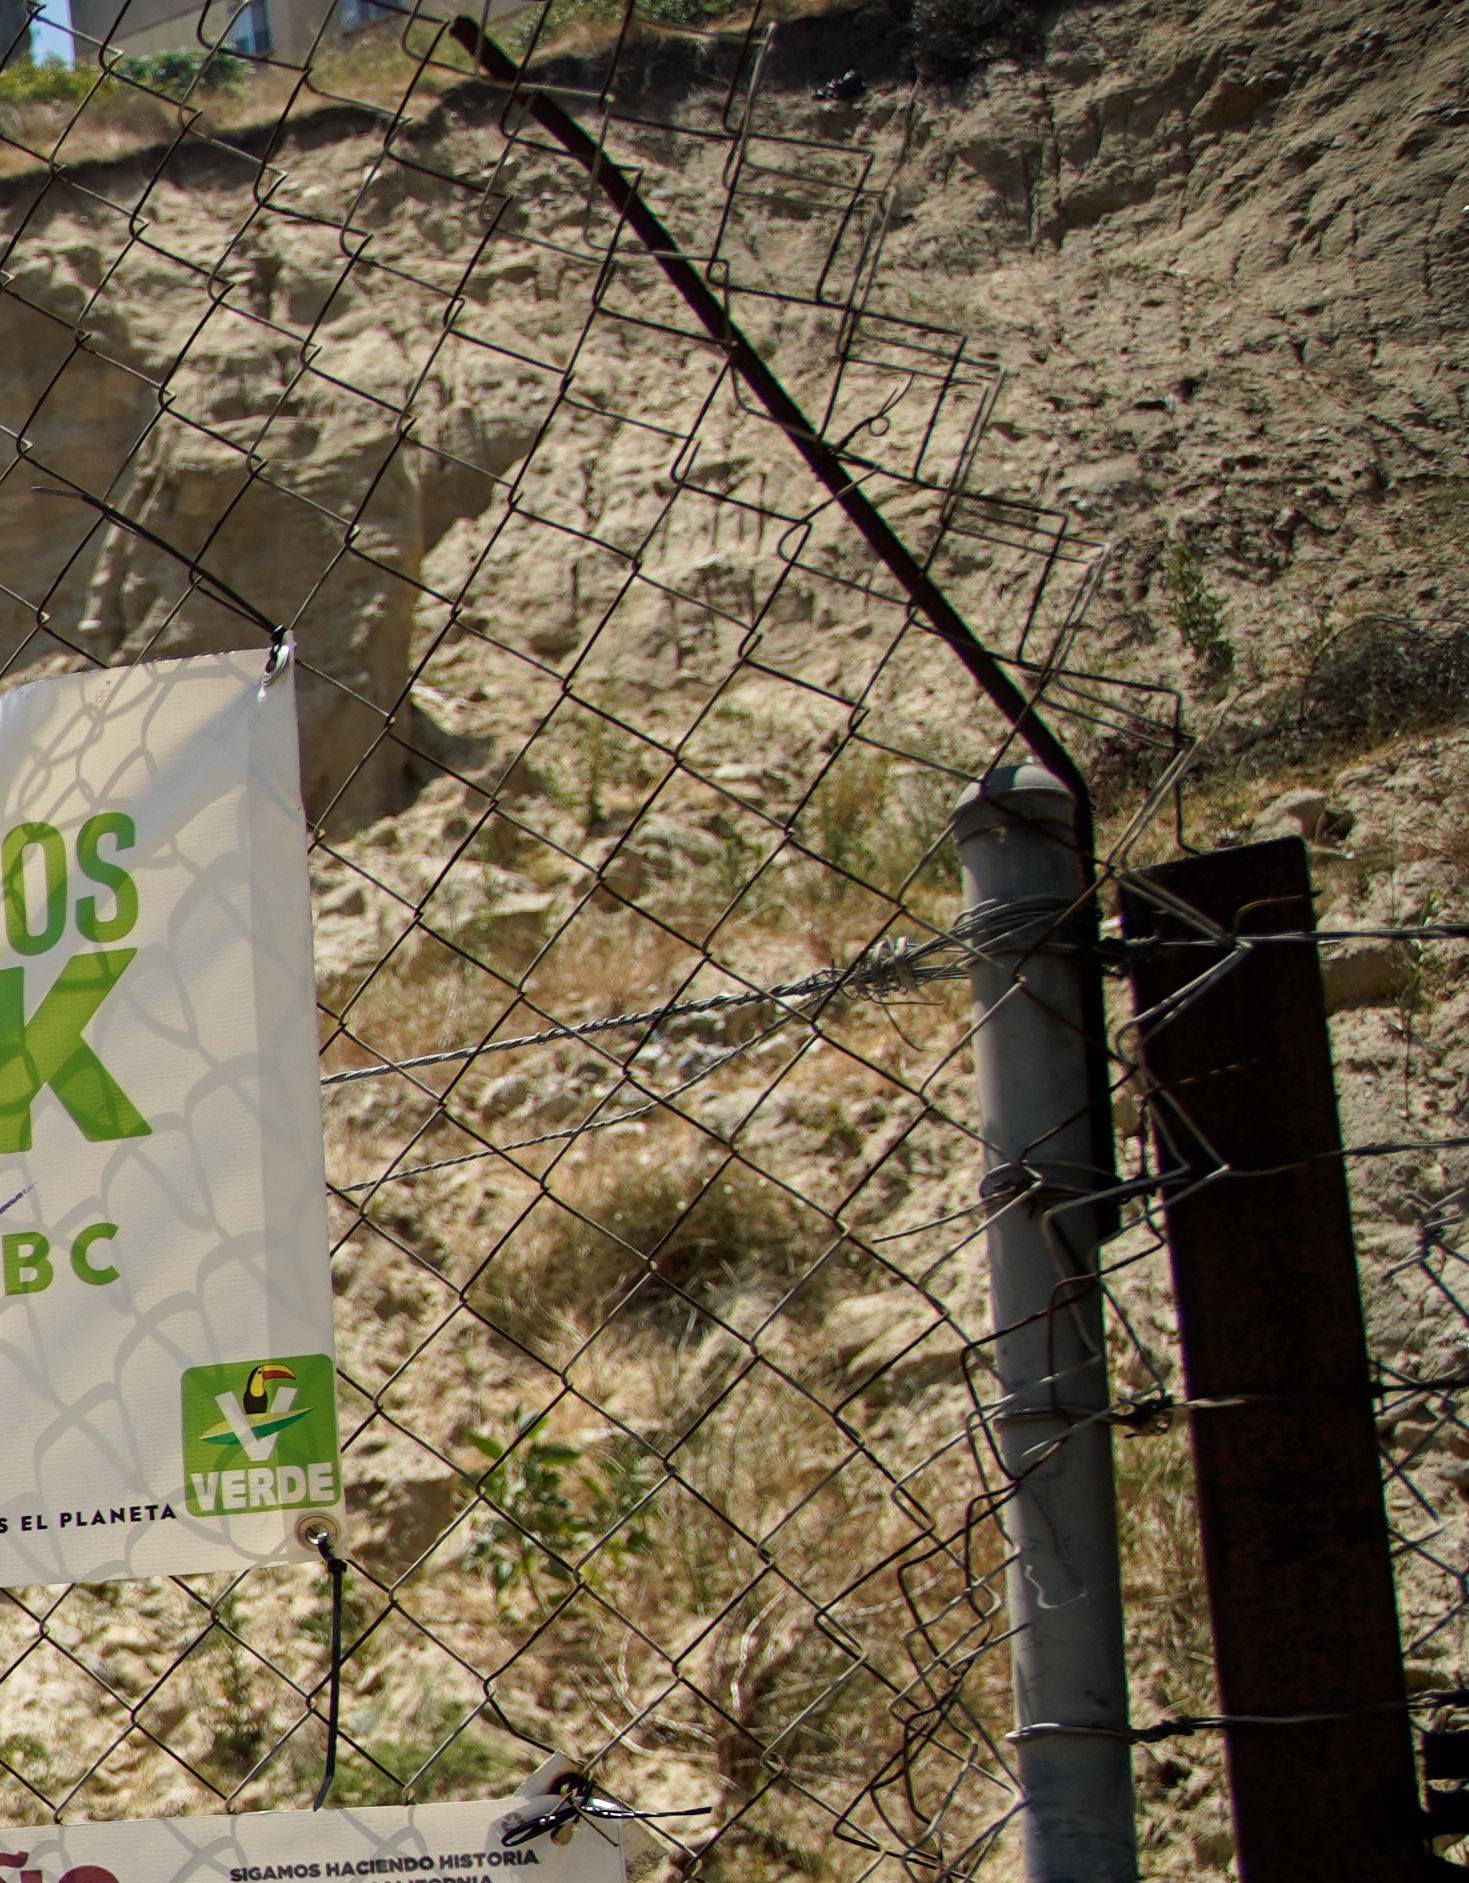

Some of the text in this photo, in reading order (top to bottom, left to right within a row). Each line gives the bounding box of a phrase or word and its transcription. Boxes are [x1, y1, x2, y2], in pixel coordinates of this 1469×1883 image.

[1, 1222, 120, 1295] BC
[191, 1462, 335, 1511] VERDE
[21, 1514, 48, 1531] EL
[59, 1503, 177, 1527] PLANETA
[230, 1849, 539, 1882] SIGAMOS HACIENDO HISTORIA
